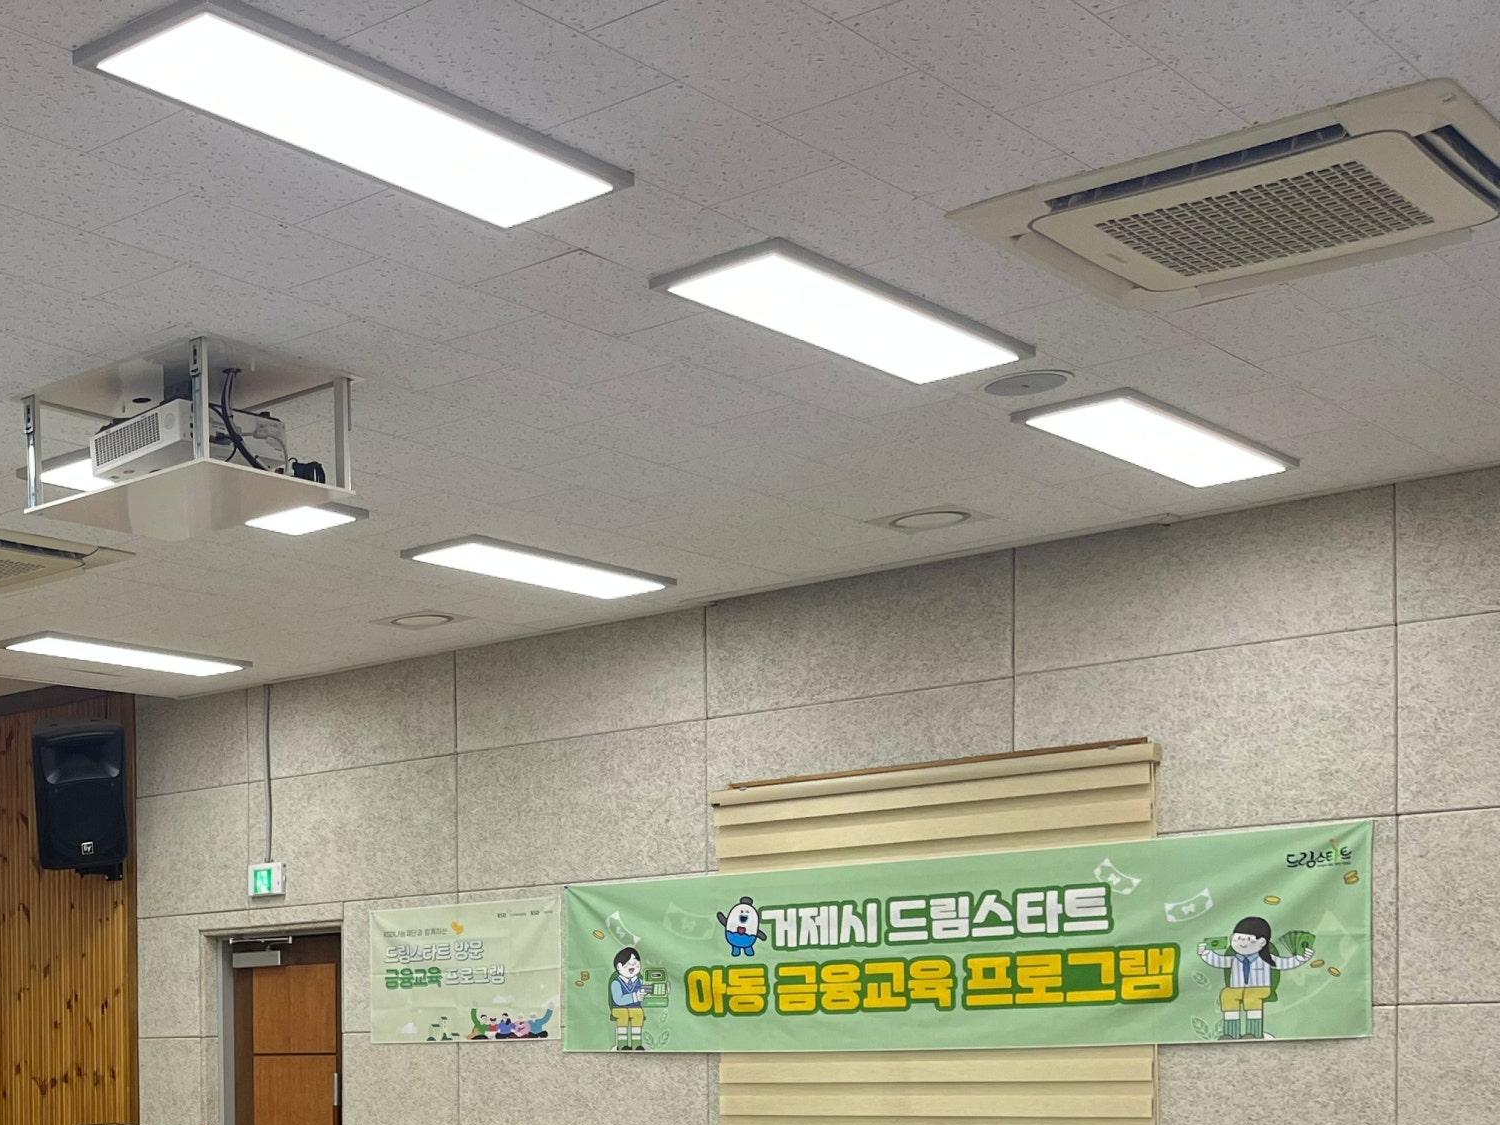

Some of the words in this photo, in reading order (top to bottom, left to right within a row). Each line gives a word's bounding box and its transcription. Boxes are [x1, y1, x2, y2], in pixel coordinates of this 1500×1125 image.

[762, 897, 878, 948] 거제시
[888, 887, 1110, 941] 드림스타트
[384, 943, 451, 964] 드림스타트
[454, 940, 484, 961] 방문
[384, 966, 442, 990] 금융교육
[445, 964, 506, 985] 프로그램
[687, 965, 766, 1014] 아동
[777, 959, 954, 1011] 금융교육
[966, 947, 1176, 1006] 프로그램
